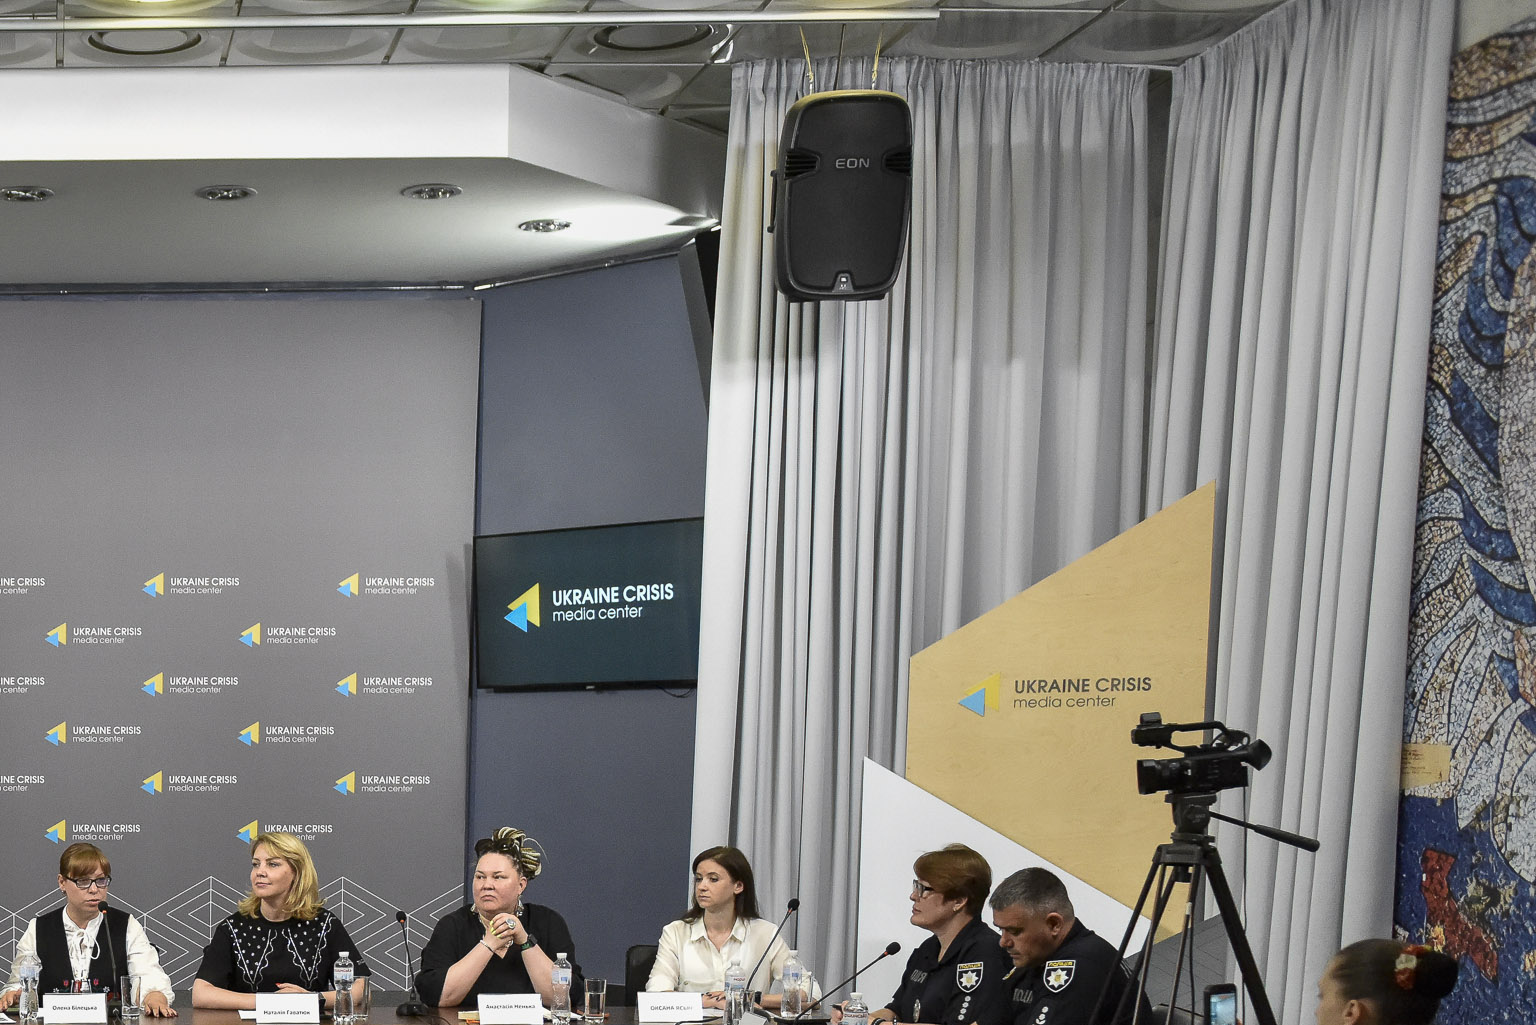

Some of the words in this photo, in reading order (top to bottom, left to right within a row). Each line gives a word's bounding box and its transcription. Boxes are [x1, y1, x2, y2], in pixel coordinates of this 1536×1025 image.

[836, 158, 870, 169] EON
[16, 577, 46, 587] CRISIS
[170, 577, 210, 587] UKRAINE
[211, 577, 240, 587] CRISIS
[365, 577, 405, 587] UKRAINE
[405, 577, 435, 587] CRISIS
[2, 586, 28, 595] center
[170, 586, 196, 594] media
[196, 586, 222, 594] center
[364, 586, 391, 595] media
[391, 587, 418, 595] center
[552, 586, 619, 607] UKRAINE
[622, 583, 675, 603] CRISIS
[552, 606, 596, 622] media
[598, 604, 643, 620] center
[73, 627, 112, 636] UKRAINE
[113, 627, 142, 636] CRISIS
[267, 627, 306, 636] UKRAINE
[307, 627, 337, 637] CRISIS
[72, 636, 99, 644] media
[99, 636, 125, 644] center
[266, 636, 293, 644] media
[293, 636, 319, 644] center
[16, 676, 45, 686] CRISIS
[169, 676, 209, 686] UKRAINE
[210, 676, 239, 686] CRISIS
[363, 677, 403, 686] UKRAINE
[403, 676, 433, 686] CRISIS
[1013, 678, 1091, 694] UKRAINE
[1095, 676, 1152, 692] CRISIS
[2, 686, 28, 694] center
[169, 685, 195, 694] media
[195, 686, 222, 694] center
[363, 686, 389, 694] media
[389, 686, 415, 694] center
[1013, 696, 1062, 708] media
[1065, 695, 1116, 708] center
[72, 726, 112, 735] UKRAINE
[112, 725, 142, 735] CRISIS
[265, 726, 305, 735] UKRAINE
[306, 726, 335, 736] CRISIS
[72, 735, 98, 743] media
[98, 735, 125, 743] center
[265, 735, 291, 743] media
[291, 735, 318, 743] center
[16, 775, 45, 784] CRISIS
[168, 775, 208, 784] UKRAINE
[208, 775, 238, 784] CRISIS
[361, 775, 401, 785] UKRAINE
[401, 775, 431, 785] CRISIS
[2, 784, 28, 792] center
[168, 784, 194, 792] media
[194, 784, 221, 792] center
[361, 784, 387, 793] media
[387, 785, 413, 793] center
[72, 824, 111, 833] UKRAINE
[112, 823, 141, 833] CRISIS
[264, 824, 303, 833] UKRAINE
[304, 824, 333, 833] CRISIS
[72, 833, 98, 841] media
[98, 833, 124, 841] center
